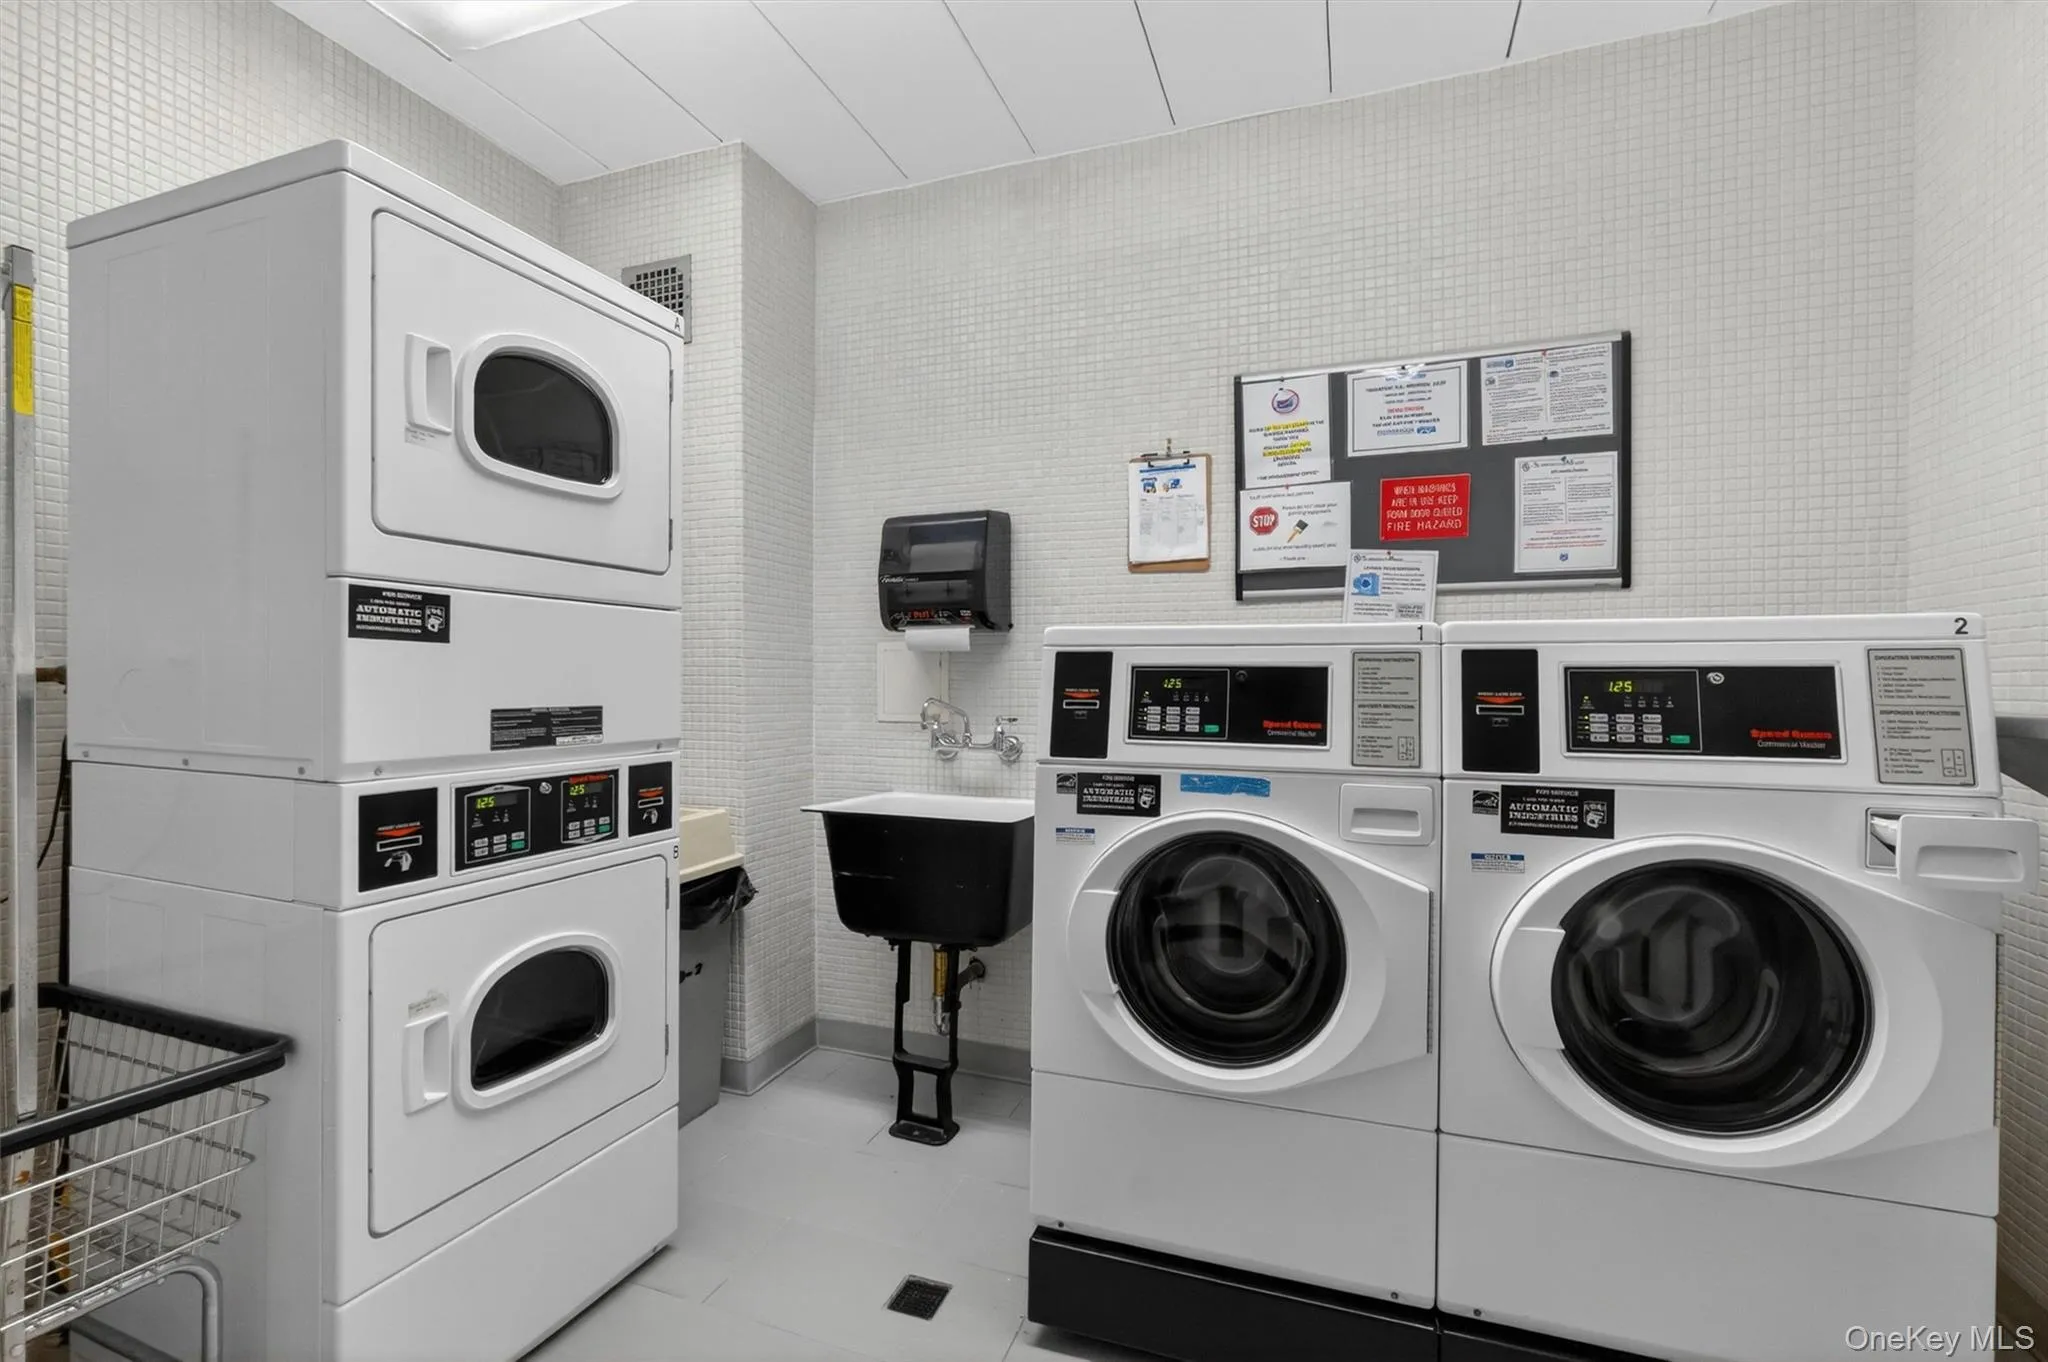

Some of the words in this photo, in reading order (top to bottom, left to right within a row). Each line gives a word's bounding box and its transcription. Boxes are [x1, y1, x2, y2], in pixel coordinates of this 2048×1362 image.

[674, 316, 681, 332] A
[1252, 513, 1275, 528] STOP
[1386, 521, 1412, 532] FIRE
[1417, 519, 1462, 531] HAZARD
[356, 604, 422, 617] AUTOMATIC
[356, 613, 422, 626] INDUSTRIES
[1954, 617, 1969, 635] 2
[1417, 625, 1423, 641] 1
[1509, 802, 1579, 814] AUTOMATIC
[1509, 811, 1578, 822] INDUSTRIES
